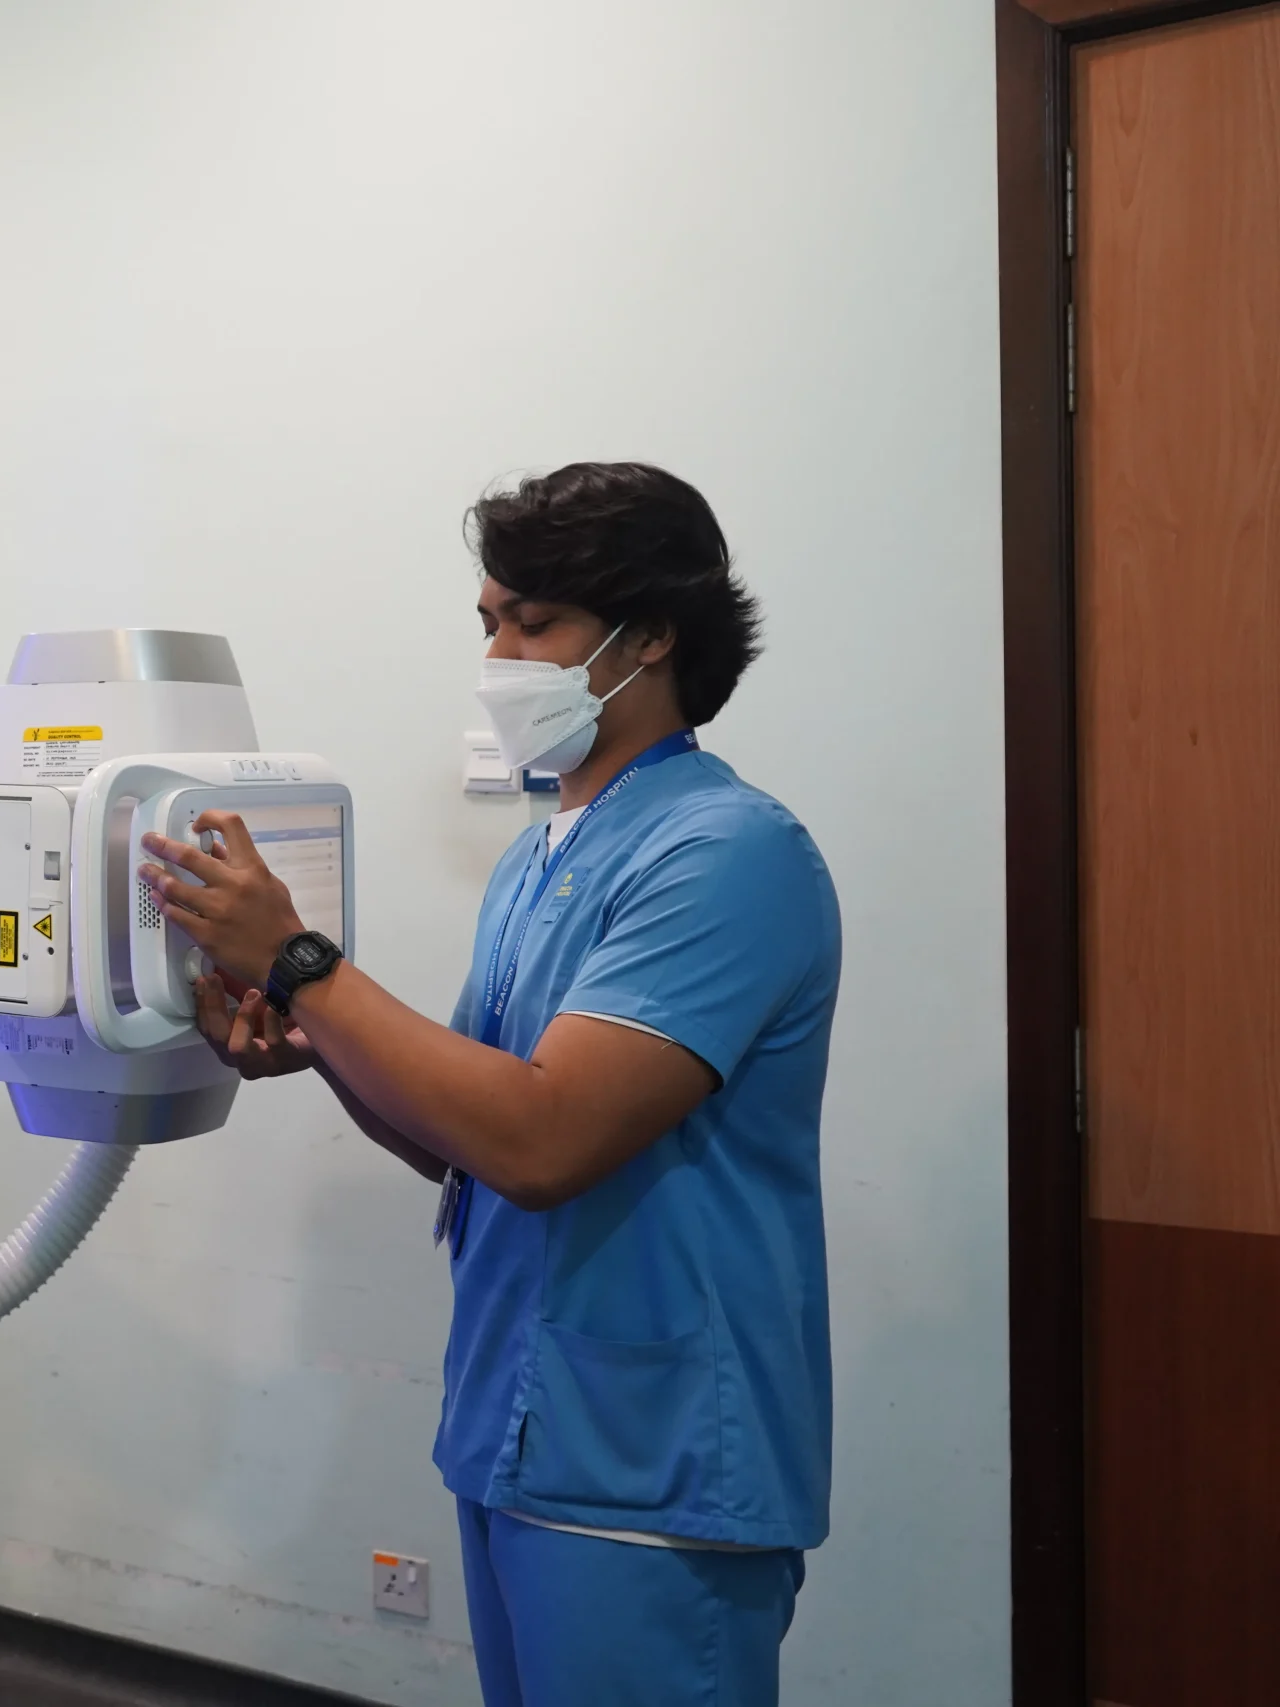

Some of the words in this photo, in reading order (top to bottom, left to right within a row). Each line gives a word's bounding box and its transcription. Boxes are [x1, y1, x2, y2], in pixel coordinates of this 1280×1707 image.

[684, 733, 697, 744] BE
[560, 809, 592, 854] BEACON
[494, 966, 514, 1016] BEACON
